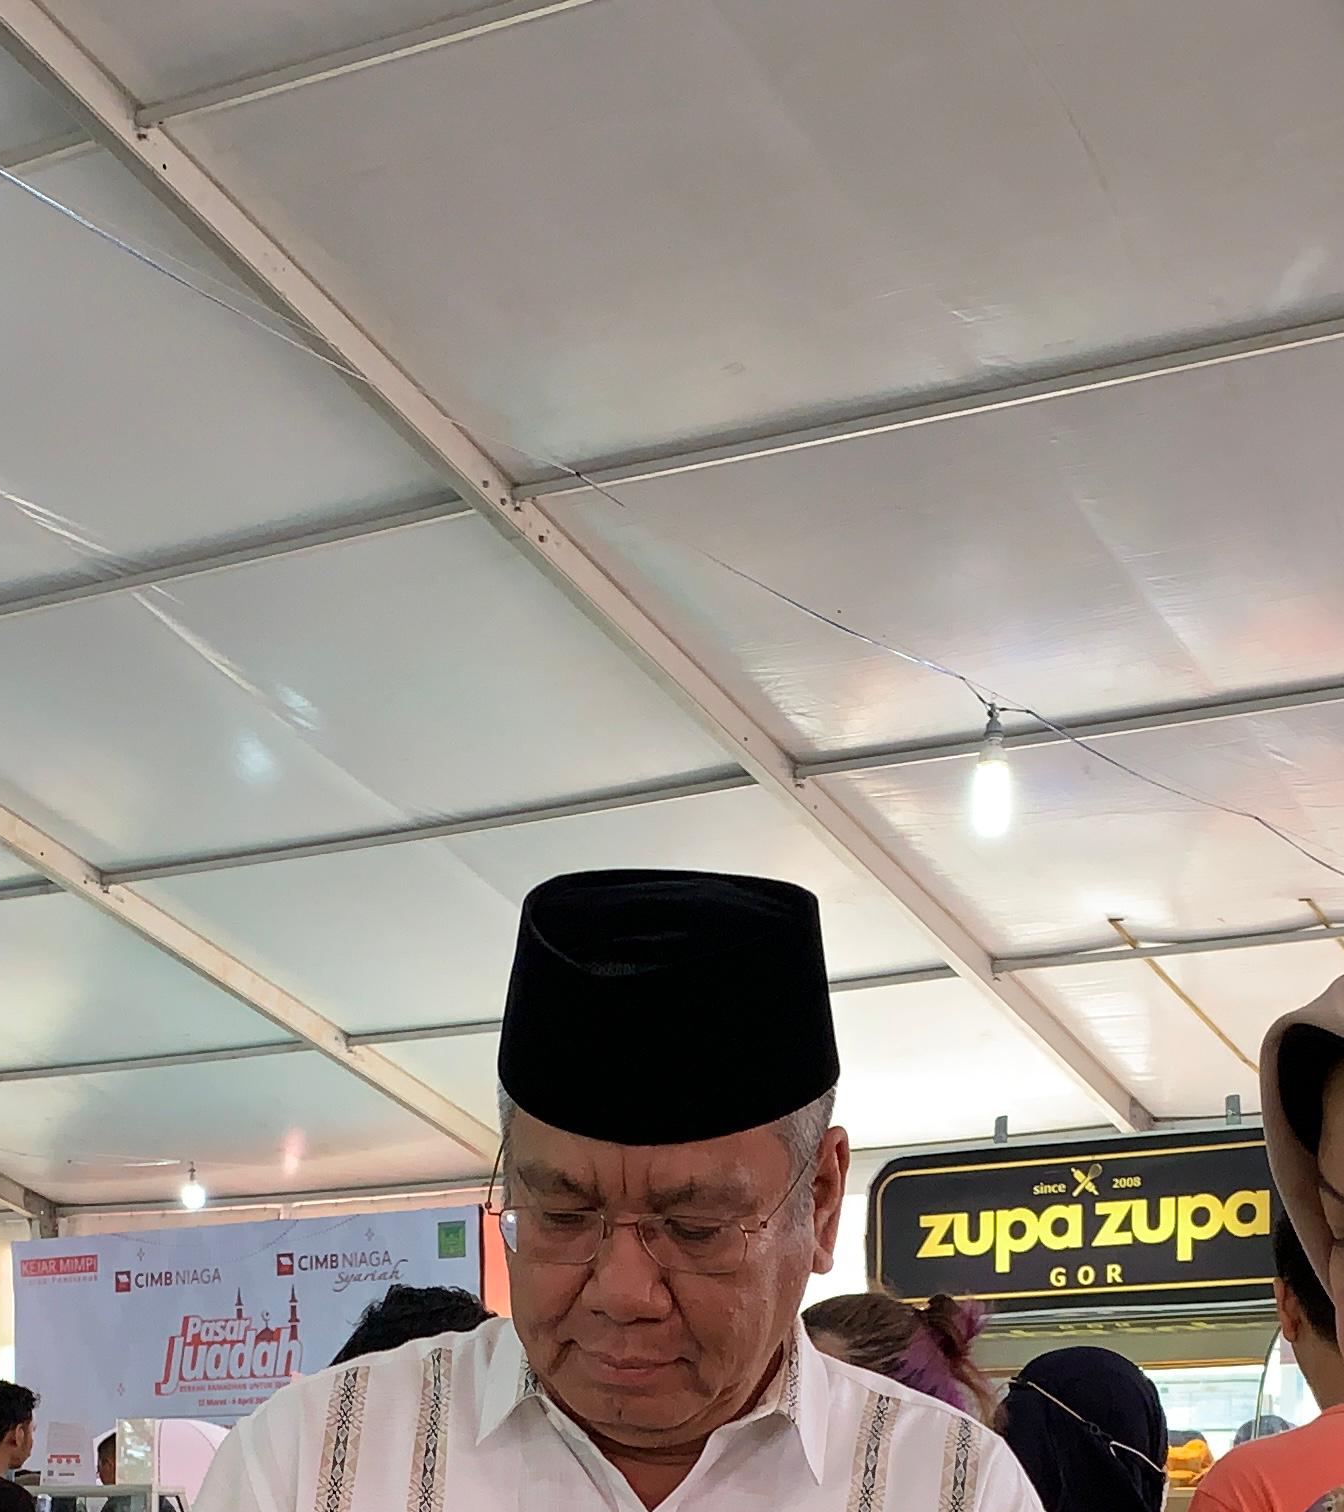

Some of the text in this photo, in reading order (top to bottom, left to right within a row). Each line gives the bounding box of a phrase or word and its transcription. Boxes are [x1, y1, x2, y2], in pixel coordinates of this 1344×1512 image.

[1032, 1176, 1142, 1196] since 2008
[915, 1189, 1271, 1274] zupa zupa
[21, 1256, 98, 1276] KEJAR MIMPI
[297, 1250, 393, 1271] CIMB NIAGA
[134, 1267, 222, 1289] CIMB NIAGA
[183, 1316, 251, 1342] Pasar
[156, 1328, 303, 1395] Juadah
